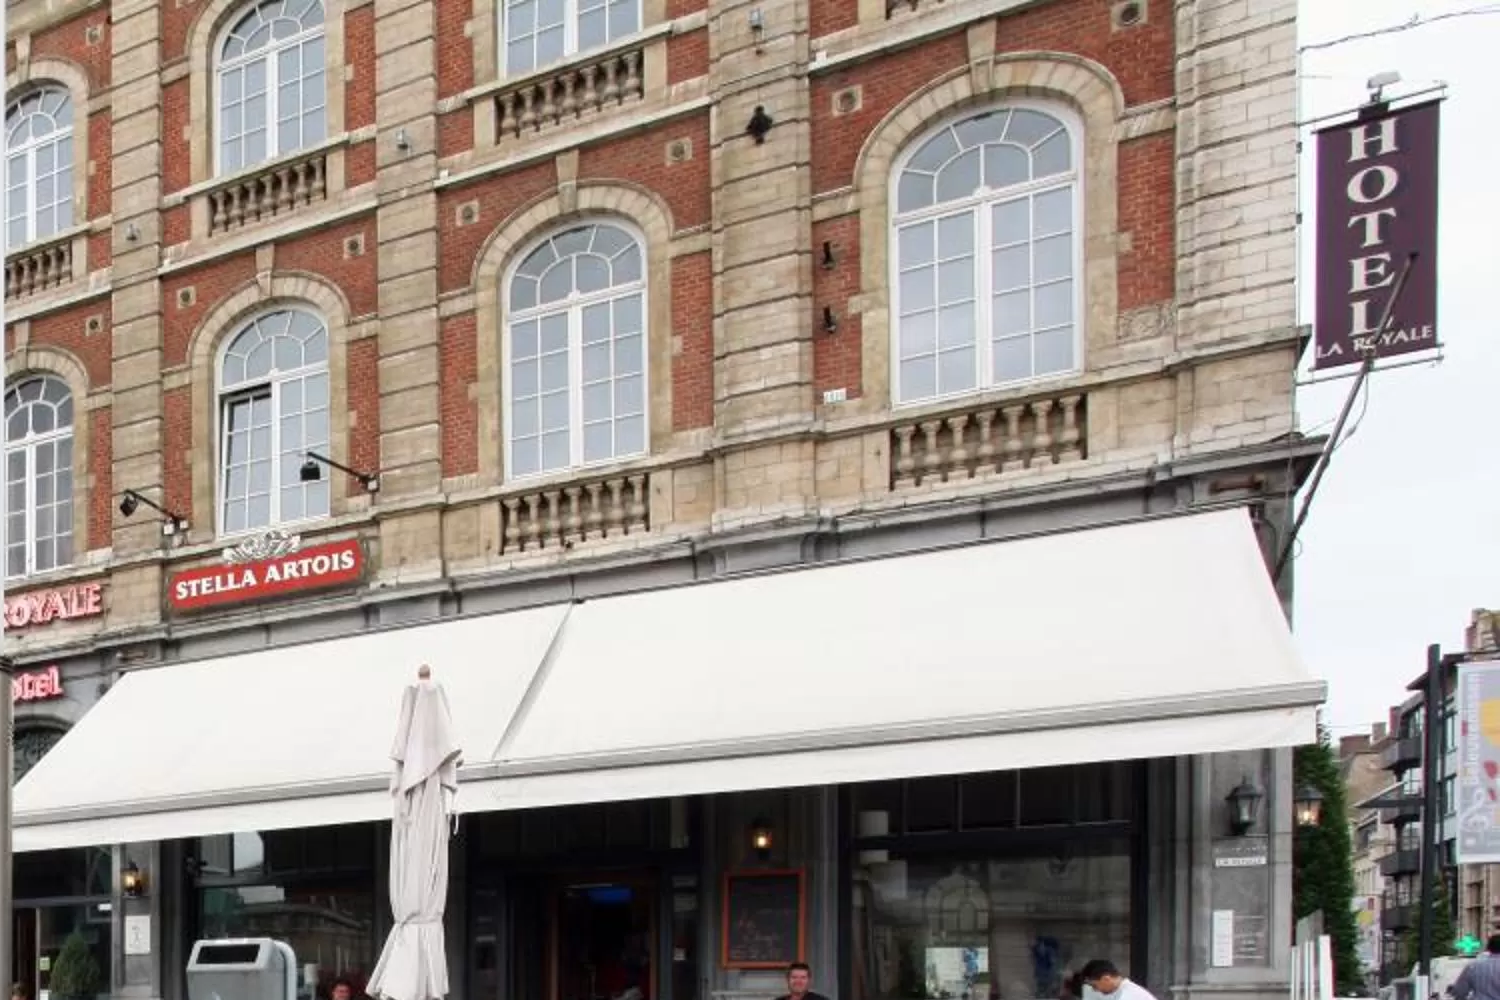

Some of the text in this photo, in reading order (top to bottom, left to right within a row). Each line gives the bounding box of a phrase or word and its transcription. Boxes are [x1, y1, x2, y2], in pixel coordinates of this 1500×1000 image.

[1347, 116, 1399, 337] HOTEL
[1316, 342, 1344, 359] LA
[175, 549, 356, 600] STELLA ARTOIS
[3, 583, 102, 630] OYALE
[11, 665, 64, 700] otel
